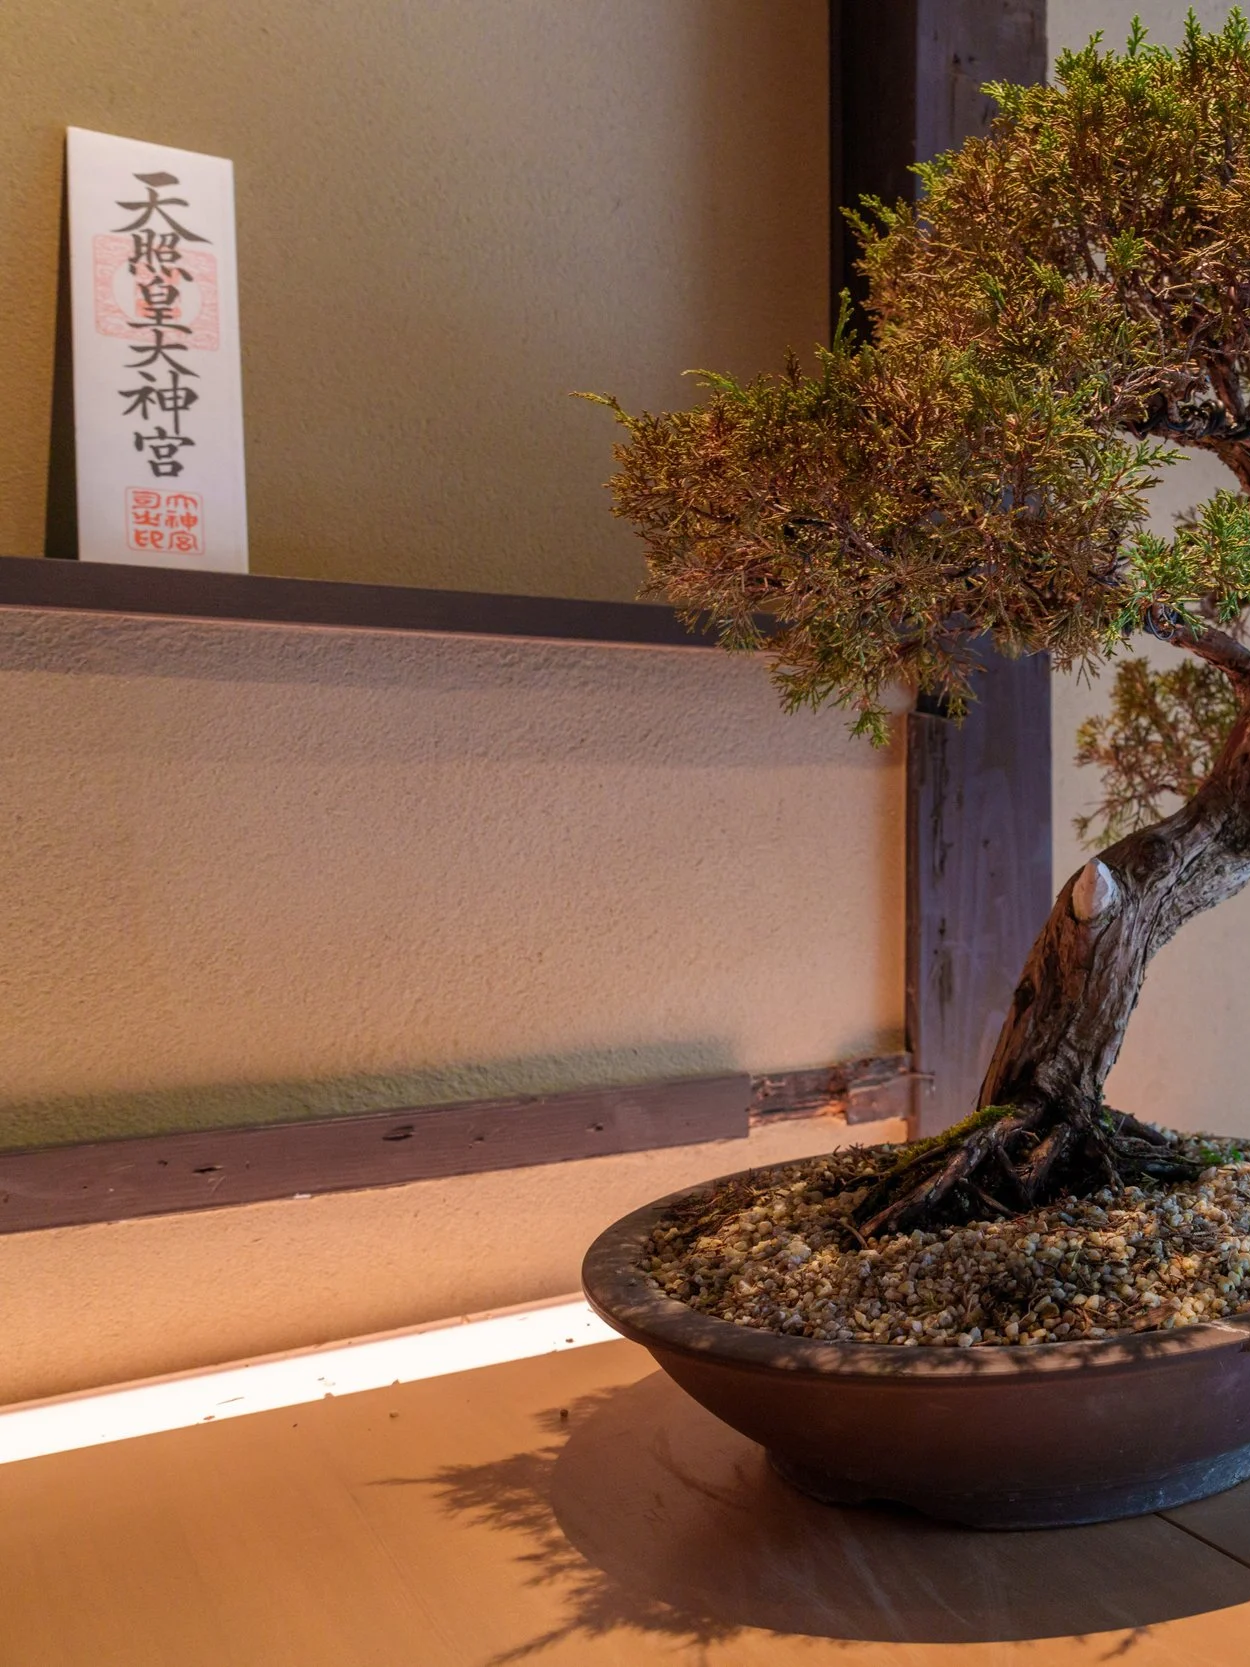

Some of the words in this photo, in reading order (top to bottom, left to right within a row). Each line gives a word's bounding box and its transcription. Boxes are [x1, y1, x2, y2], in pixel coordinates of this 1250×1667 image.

[110, 172, 213, 478] 天照皇大神宮
